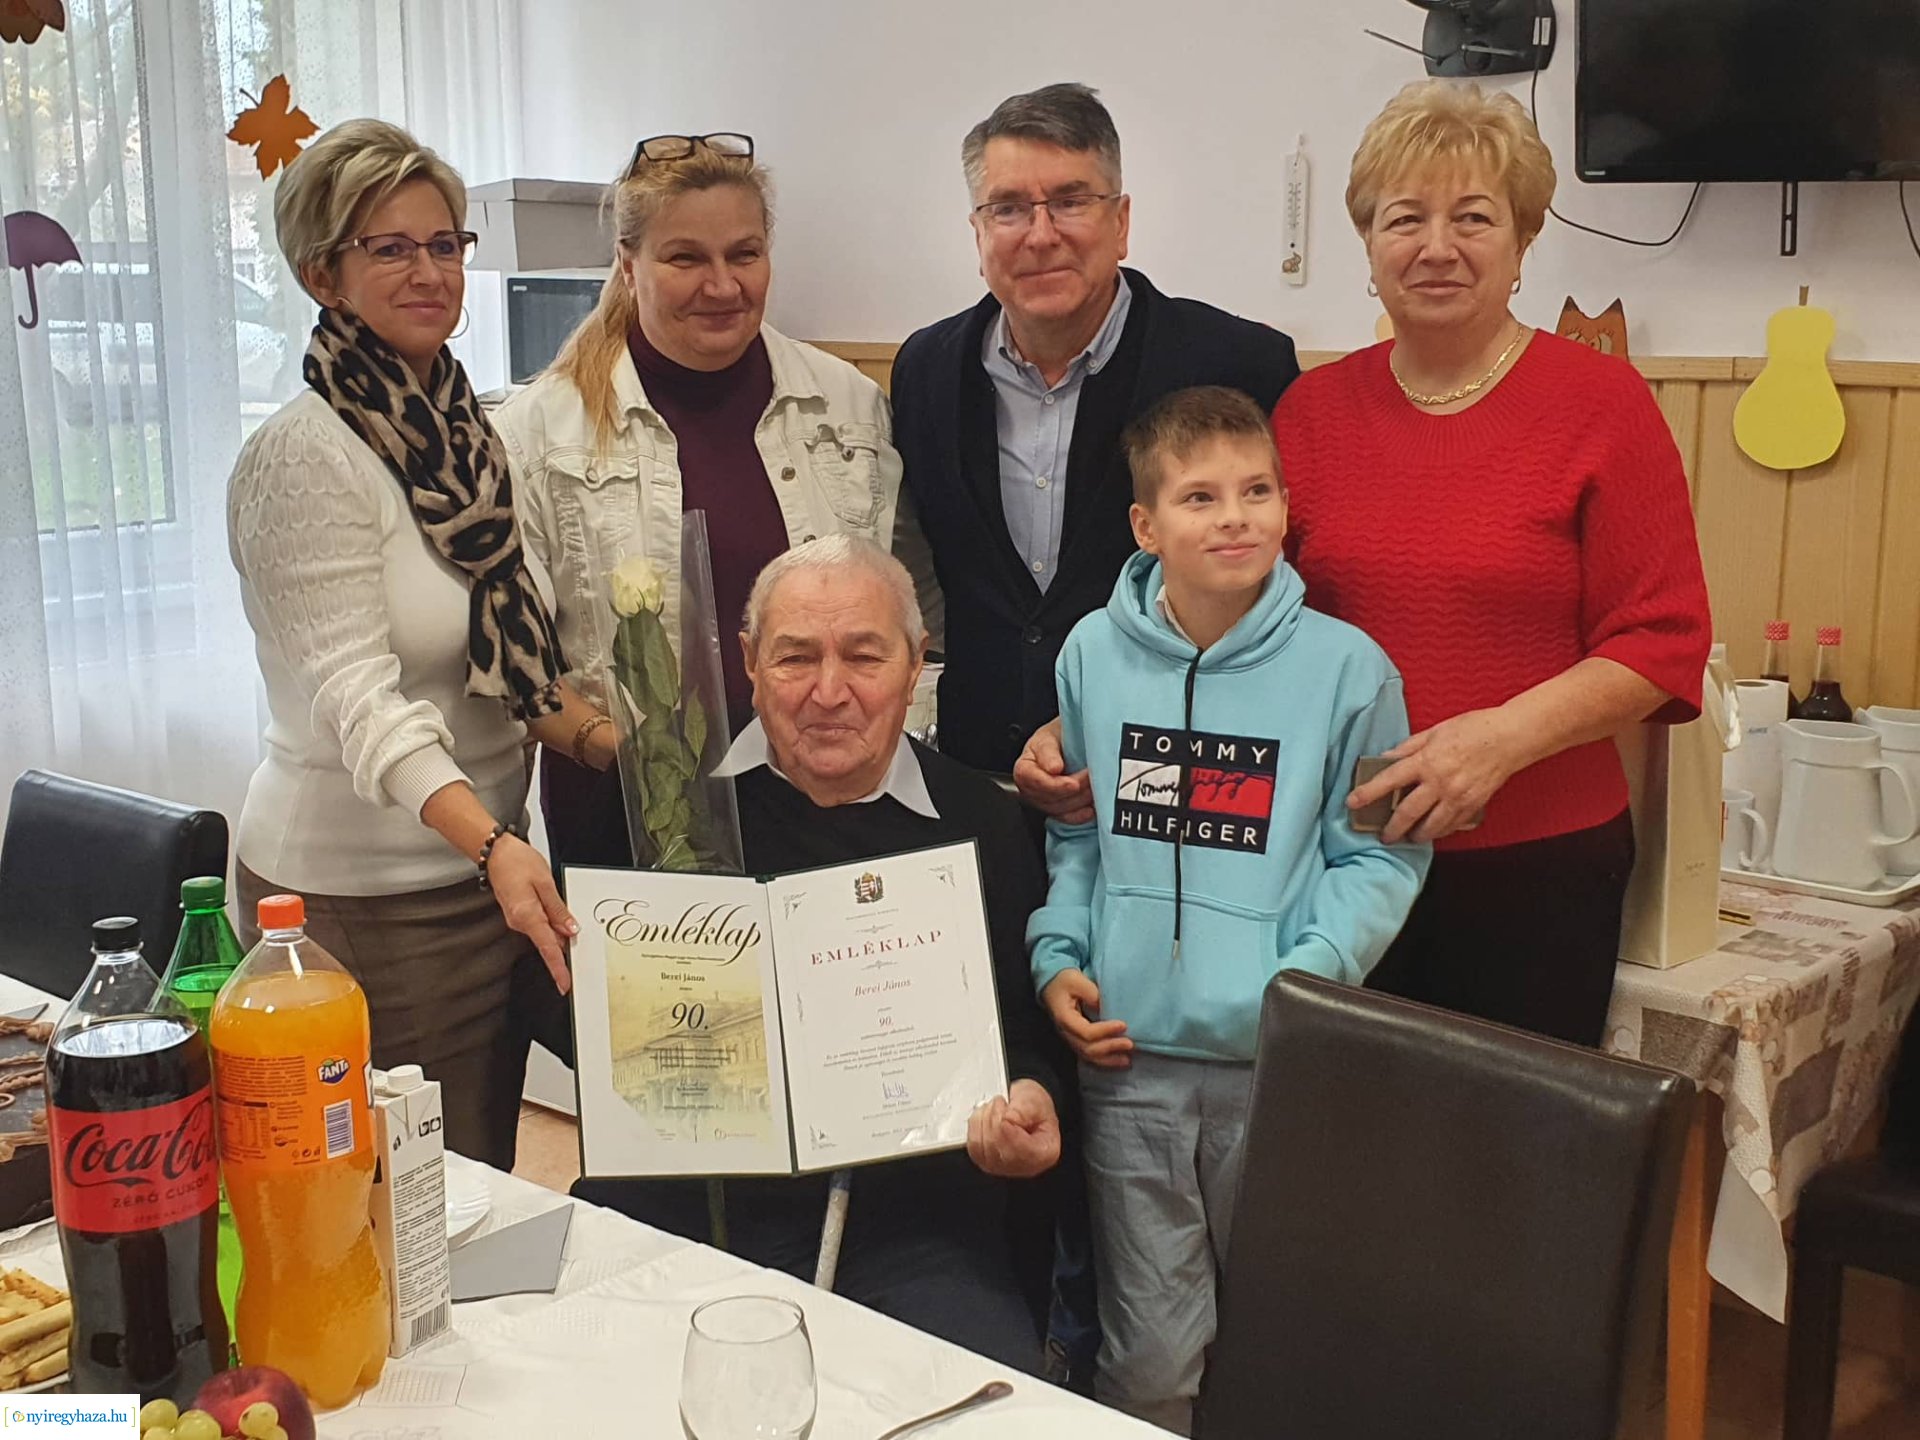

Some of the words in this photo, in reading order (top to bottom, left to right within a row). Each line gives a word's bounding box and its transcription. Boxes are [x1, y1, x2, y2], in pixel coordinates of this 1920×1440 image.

[1129, 732, 1268, 765] TOMMY
[1120, 811, 1257, 846] HILFIGER
[593, 898, 762, 967] Emléklap
[811, 929, 942, 966] EMLÉKLAP
[882, 977, 912, 992] János
[670, 1001, 710, 1031] 90.
